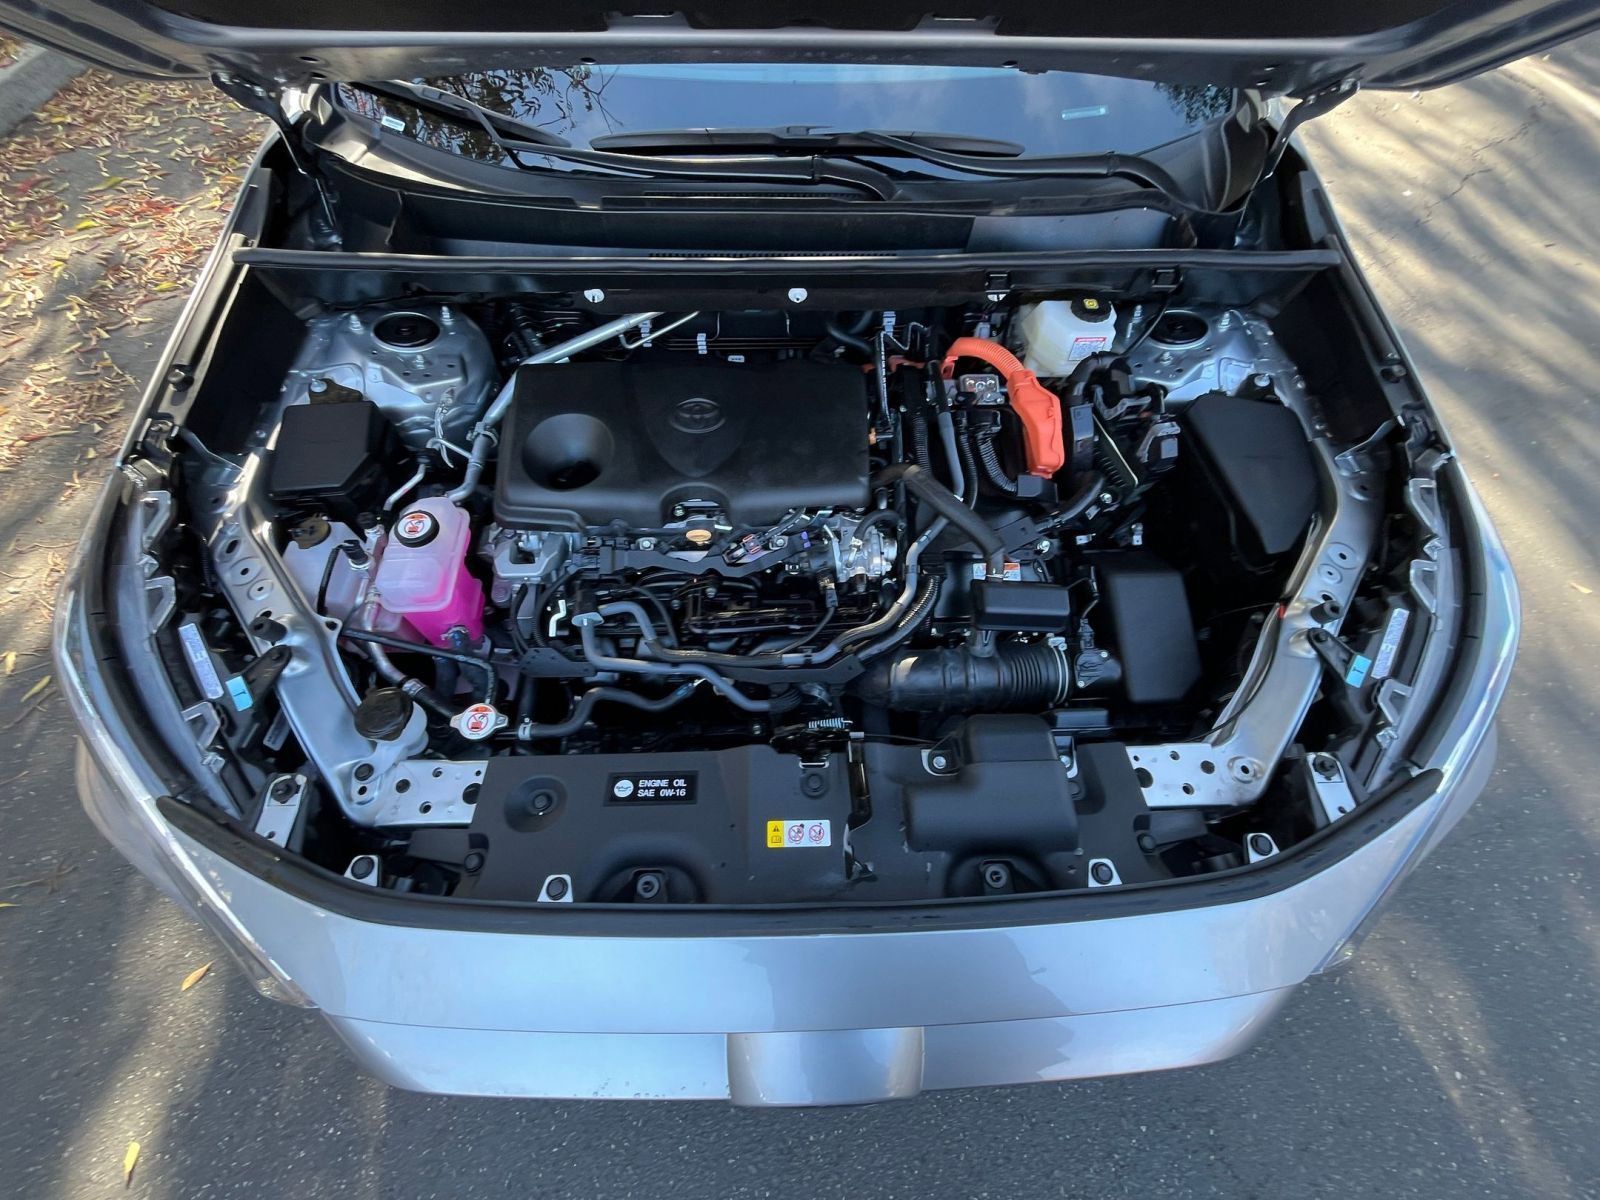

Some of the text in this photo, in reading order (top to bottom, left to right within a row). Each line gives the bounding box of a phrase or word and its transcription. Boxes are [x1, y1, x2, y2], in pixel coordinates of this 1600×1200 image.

[638, 779, 687, 787] ENGINE OIL
[637, 788, 686, 797] SAE 0W-16
